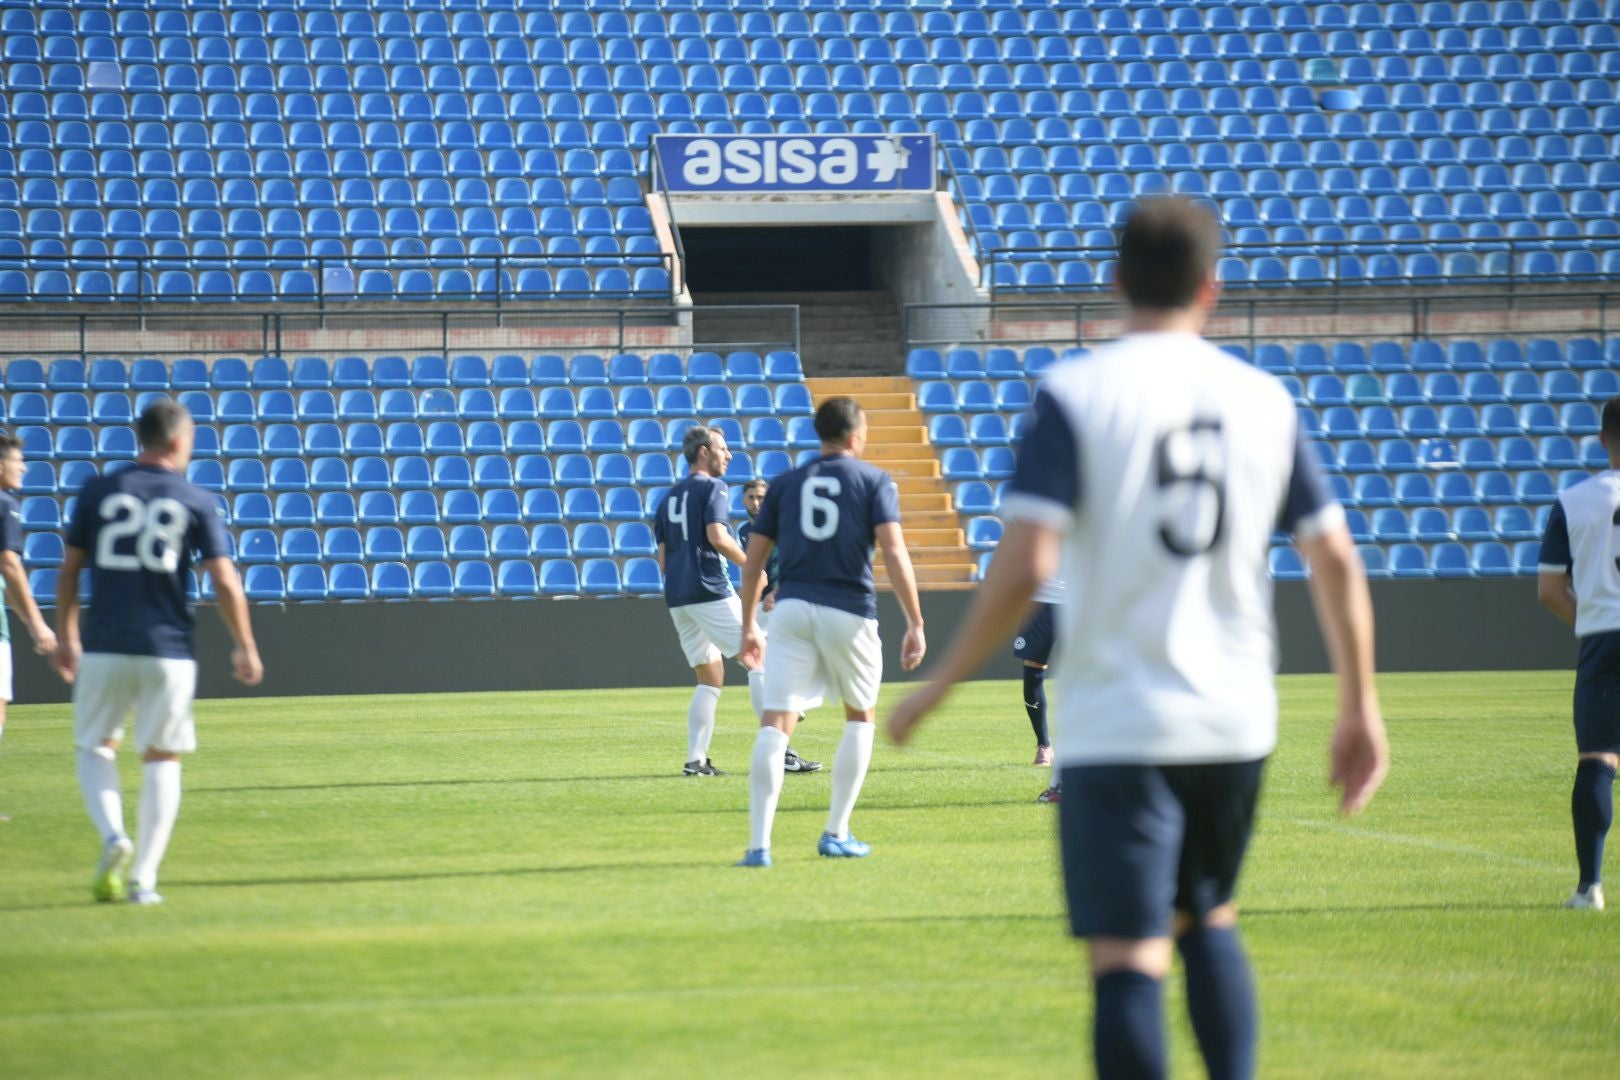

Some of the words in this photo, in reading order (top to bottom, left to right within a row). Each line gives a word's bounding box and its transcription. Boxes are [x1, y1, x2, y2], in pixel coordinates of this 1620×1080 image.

[683, 138, 858, 185] asisa
[96, 493, 189, 573] 28
[668, 491, 688, 541] 4
[801, 476, 842, 541] 6
